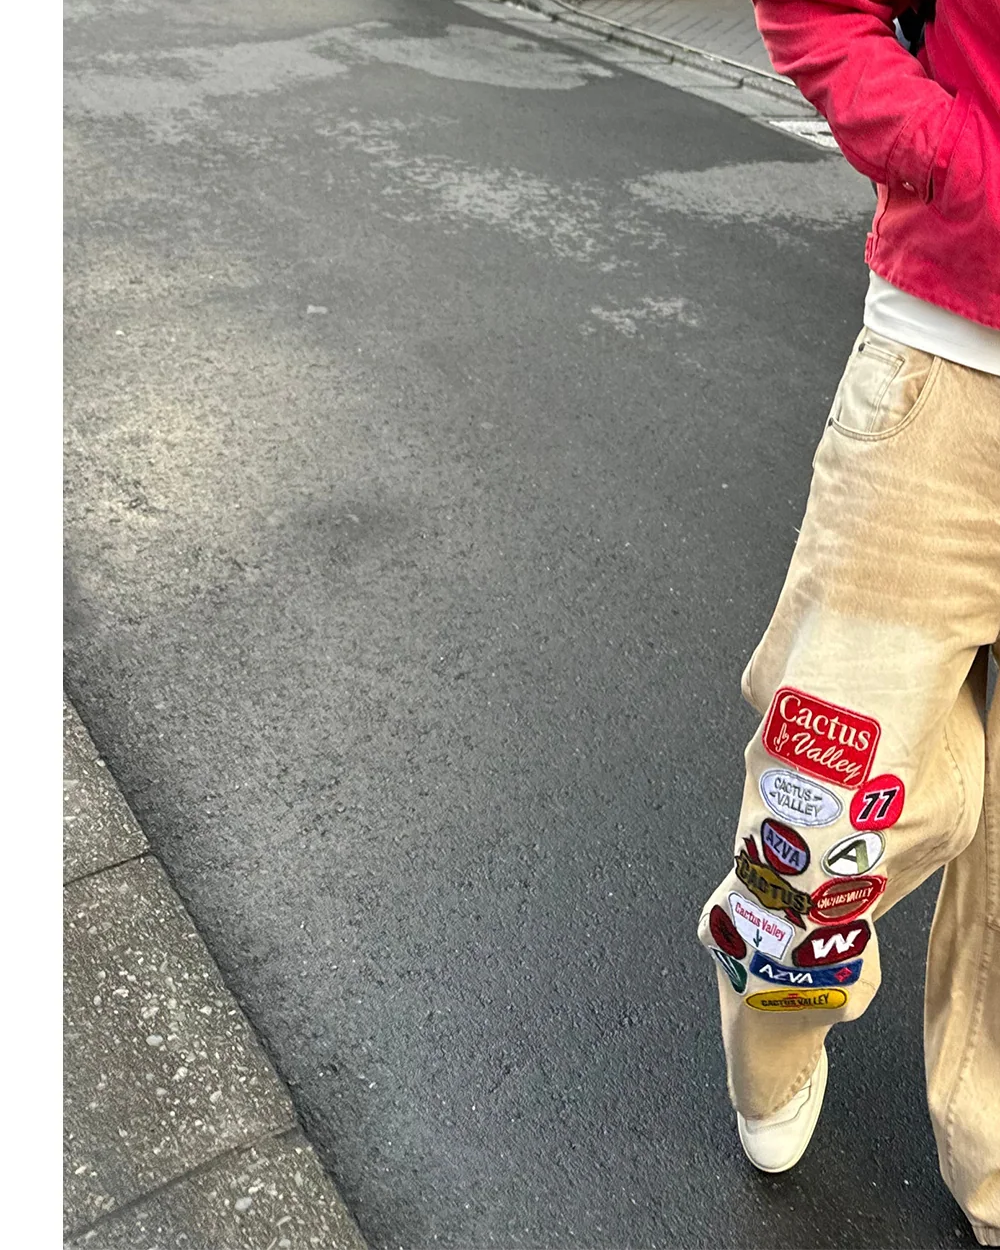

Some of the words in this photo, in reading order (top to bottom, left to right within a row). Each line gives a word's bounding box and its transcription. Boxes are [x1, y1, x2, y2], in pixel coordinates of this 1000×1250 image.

[780, 695, 871, 751] Cactus
[792, 732, 862, 782] Valley
[774, 777, 813, 801] CACTUS
[776, 792, 822, 817] VALLEY
[856, 786, 900, 822] 77
[766, 830, 800, 867] AZVA
[741, 858, 806, 909] CACTUS
[734, 902, 760, 927] Cactus
[761, 918, 786, 941] Valley
[759, 964, 813, 984] AZVA
